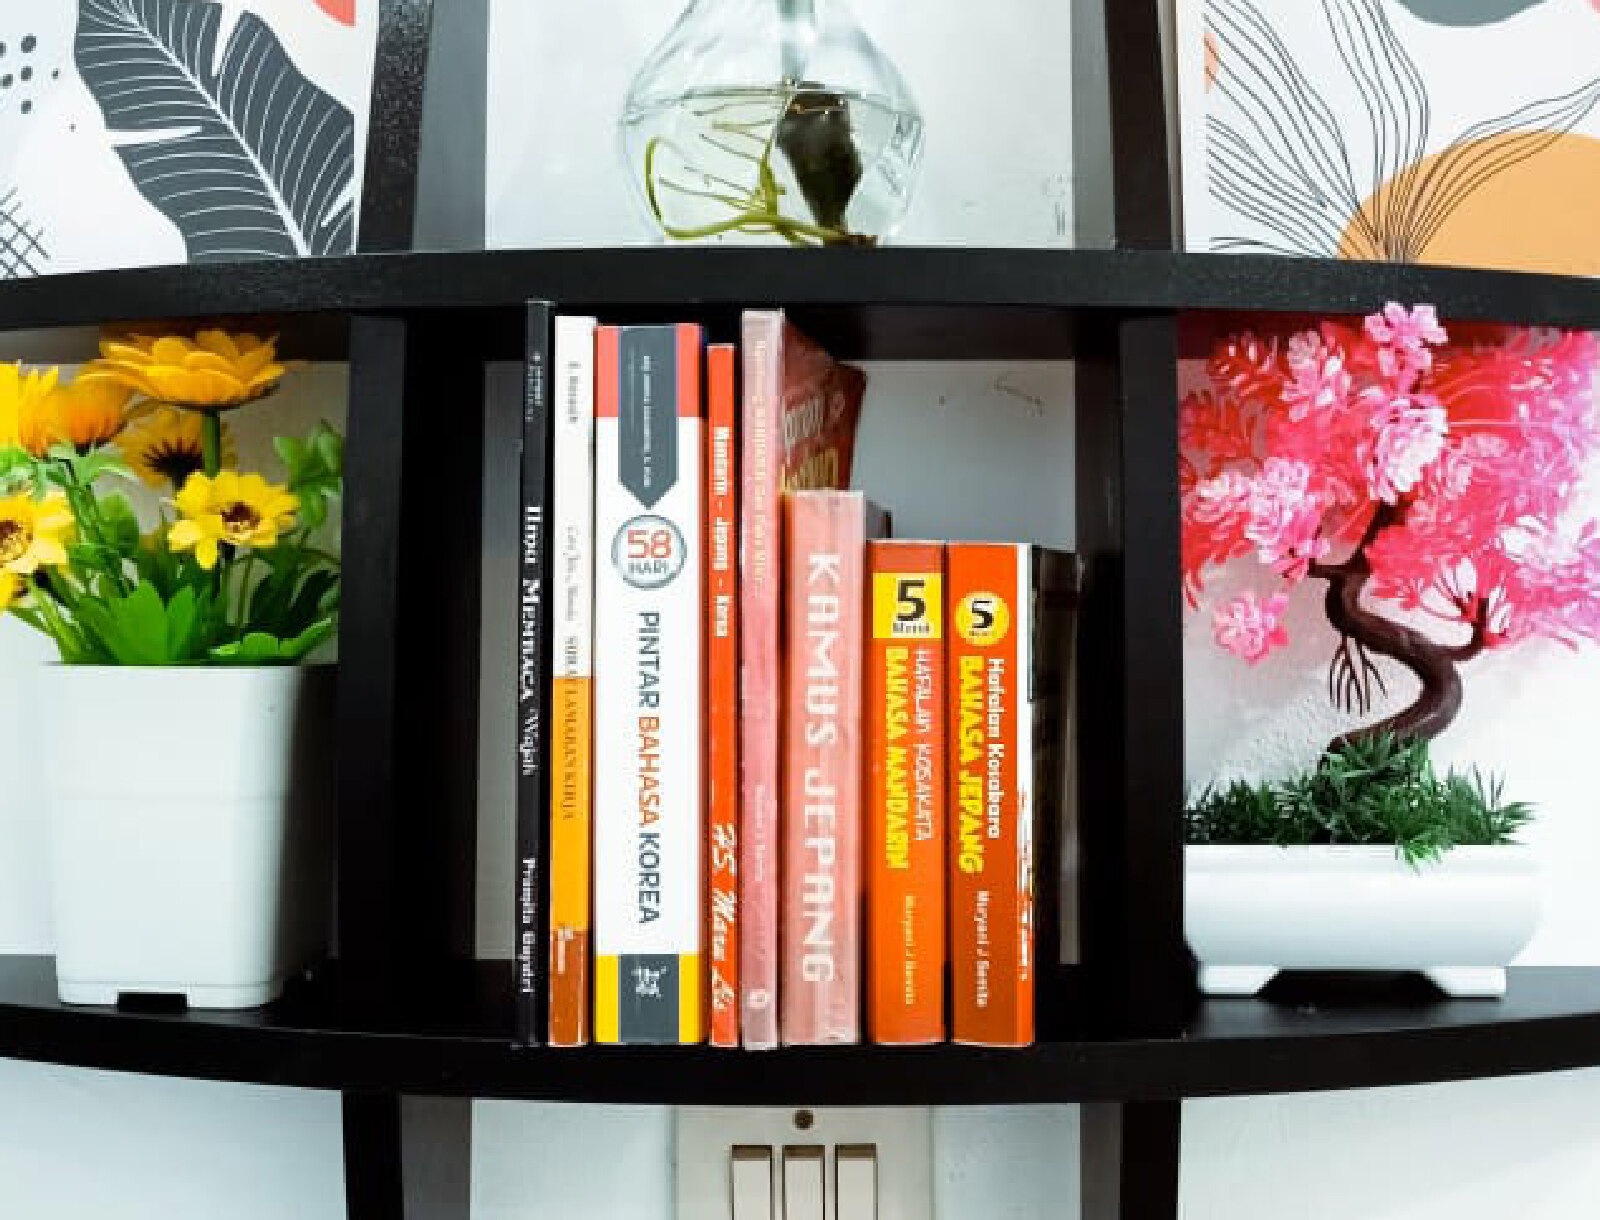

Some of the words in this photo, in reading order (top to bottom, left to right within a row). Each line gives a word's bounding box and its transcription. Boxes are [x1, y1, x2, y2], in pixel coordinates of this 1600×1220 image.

[523, 505, 543, 564] Ilmu
[627, 529, 671, 558] 58
[627, 559, 669, 573] HARI
[898, 579, 926, 621] 5
[971, 599, 994, 629] 5
[638, 611, 661, 709] PINTAR
[805, 552, 841, 746] KAMUS
[885, 645, 909, 741] BAHASA
[958, 655, 984, 764] BAHASA
[987, 657, 1005, 739] Hafalan
[638, 715, 661, 828] BAHASA
[885, 746, 909, 869] MANDARIN
[957, 768, 984, 874] JEPANG
[638, 831, 661, 924] KOREA
[801, 766, 838, 982] JEPANG
